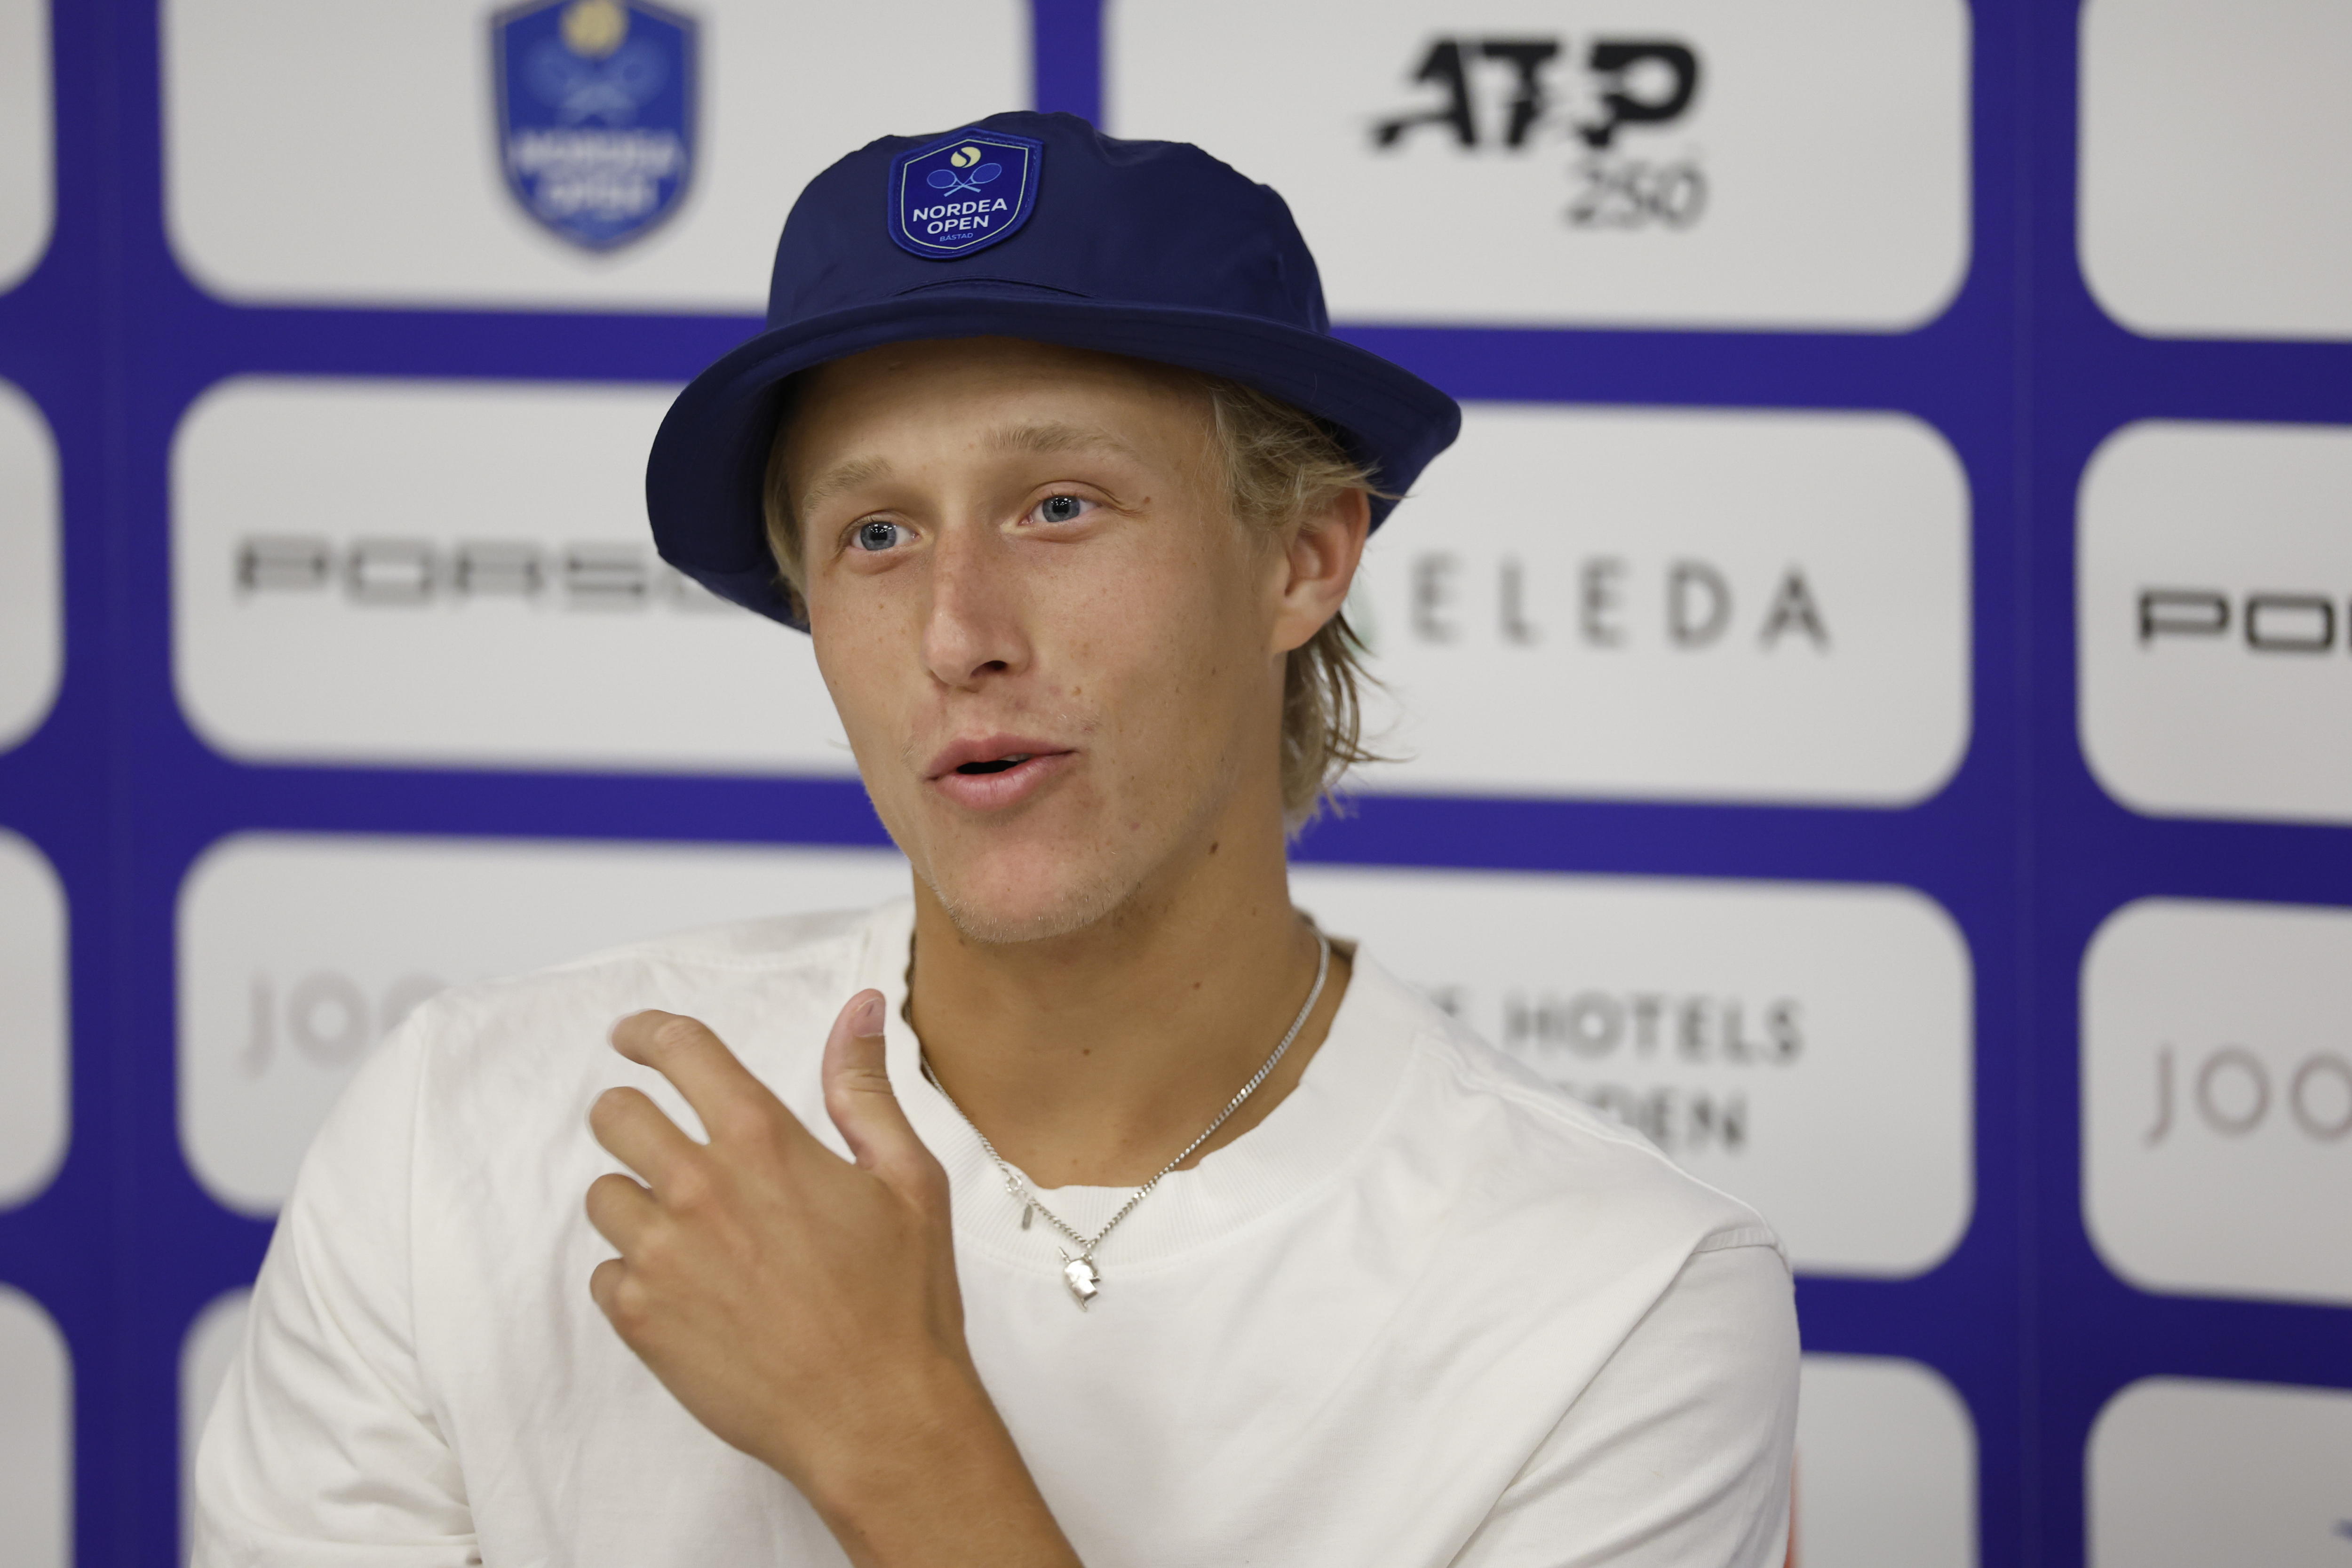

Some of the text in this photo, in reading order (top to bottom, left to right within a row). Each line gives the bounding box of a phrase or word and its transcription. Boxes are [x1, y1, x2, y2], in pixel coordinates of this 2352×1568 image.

[1373, 39, 1699, 148] ATP
[913, 198, 1008, 222] NORDEA
[927, 215, 989, 234] OPEN
[1565, 156, 1709, 231] 250
[1412, 552, 1831, 653] ELEDA
[2137, 588, 2352, 655] PO
[1503, 989, 1804, 1067] HOTELS
